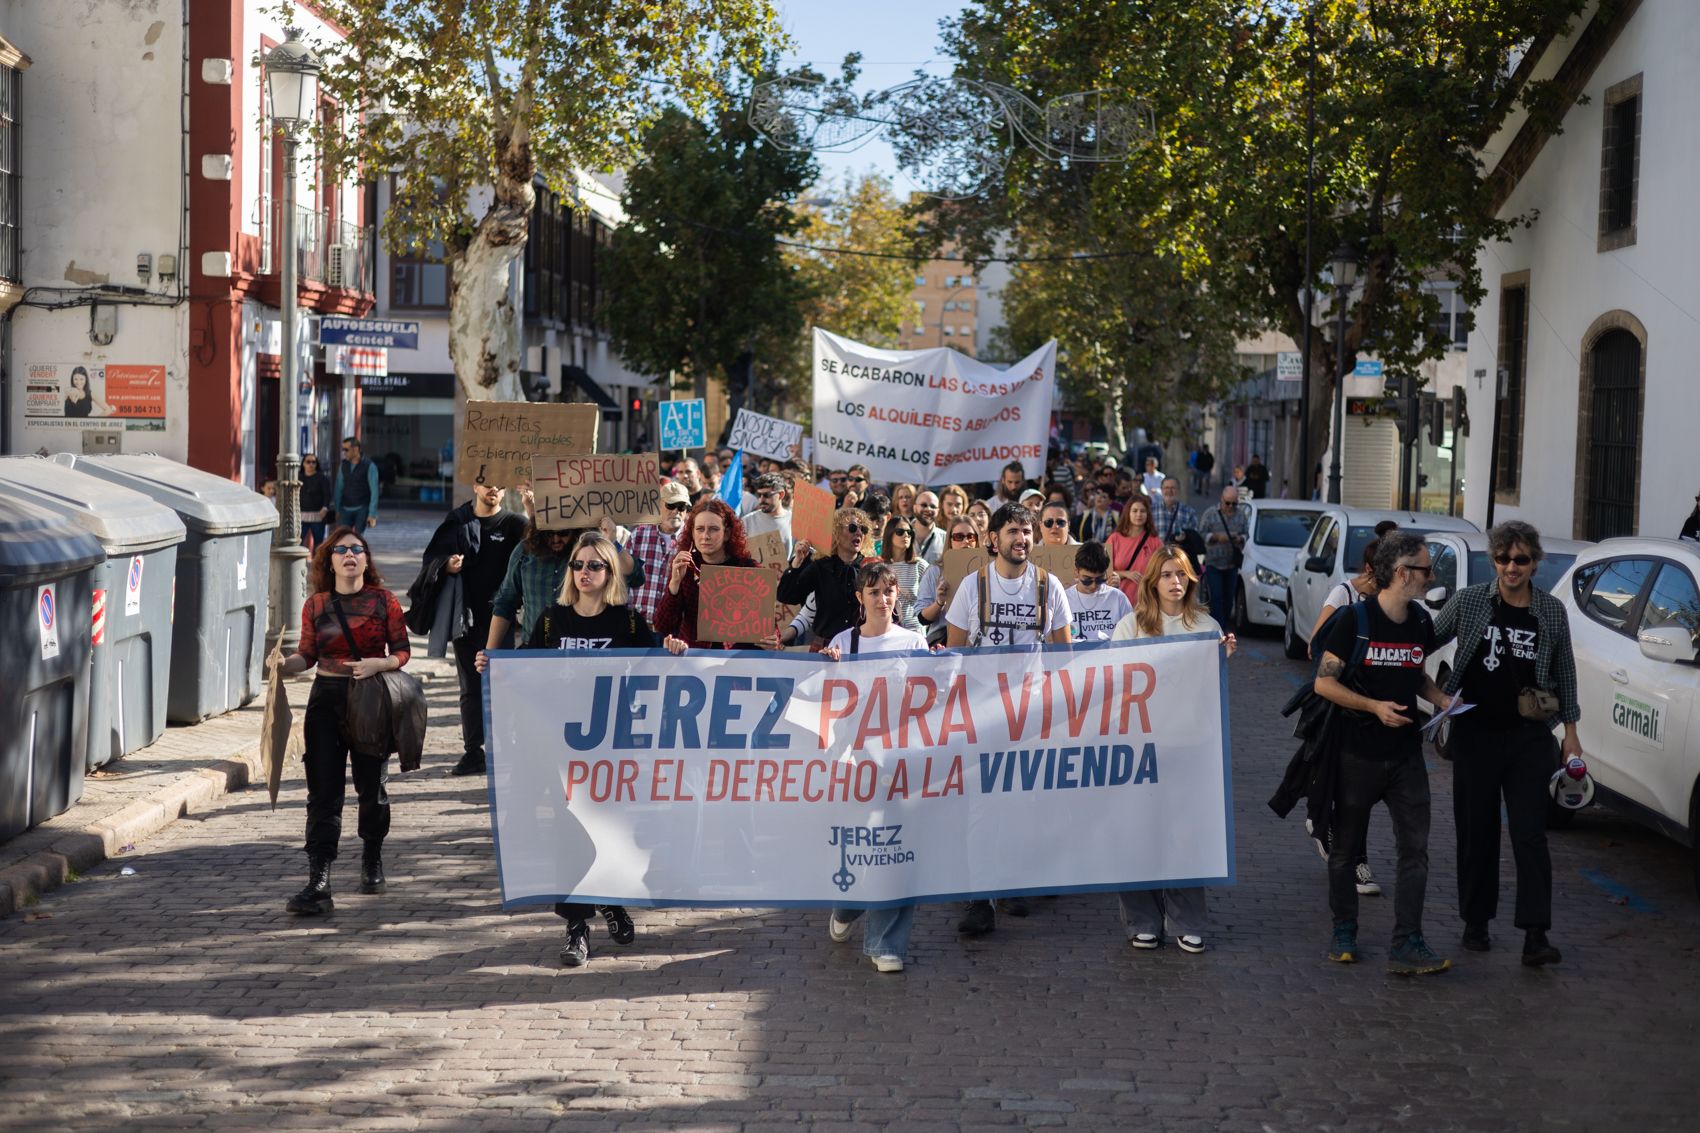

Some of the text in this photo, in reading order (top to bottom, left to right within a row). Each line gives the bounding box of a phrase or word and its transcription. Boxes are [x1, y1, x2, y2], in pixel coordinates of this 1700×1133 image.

[322, 319, 418, 333] AUTOESCUELA
[821, 359, 837, 374] SE
[841, 363, 925, 387] ACABARON
[928, 375, 958, 391] LAS
[837, 400, 865, 417] LOS
[467, 410, 541, 433] Rentistas
[819, 431, 829, 447] LA
[830, 436, 854, 453] PAZ
[857, 442, 896, 459] PARA
[901, 448, 930, 465] LOS
[990, 602, 1036, 617] JEREZ
[1072, 610, 1112, 622] JEREZ
[564, 661, 1157, 752] JEREZ PARA VIVIR
[1612, 702, 1660, 741] carmali
[565, 742, 1159, 803] POR EL DERECHO A LA VIVIENDA
[828, 824, 903, 847] JEREZ
[846, 850, 915, 866] VIVIENDA
